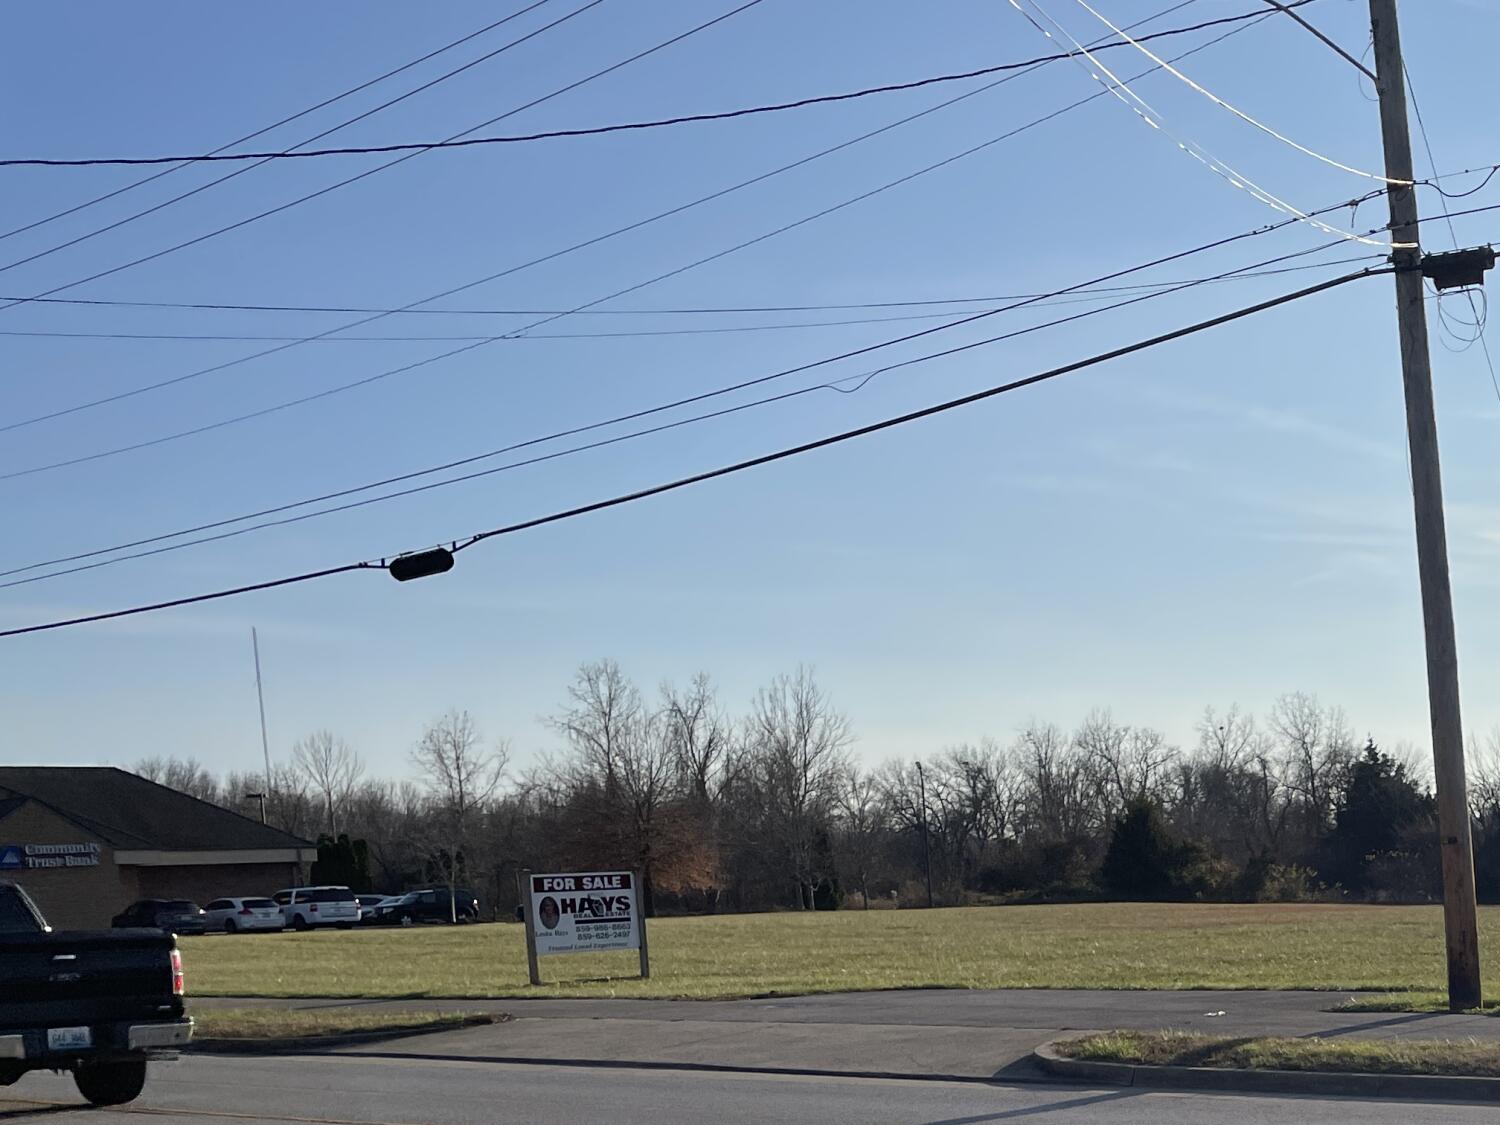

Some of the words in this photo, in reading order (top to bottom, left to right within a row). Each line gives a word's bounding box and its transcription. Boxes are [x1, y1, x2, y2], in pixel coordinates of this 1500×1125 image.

[25, 843, 100, 854] Community
[25, 856, 64, 868] Trust
[66, 854, 99, 866] Bank
[543, 878, 575, 891] FOR
[582, 876, 622, 889] SALE
[560, 895, 631, 917] HAYS
